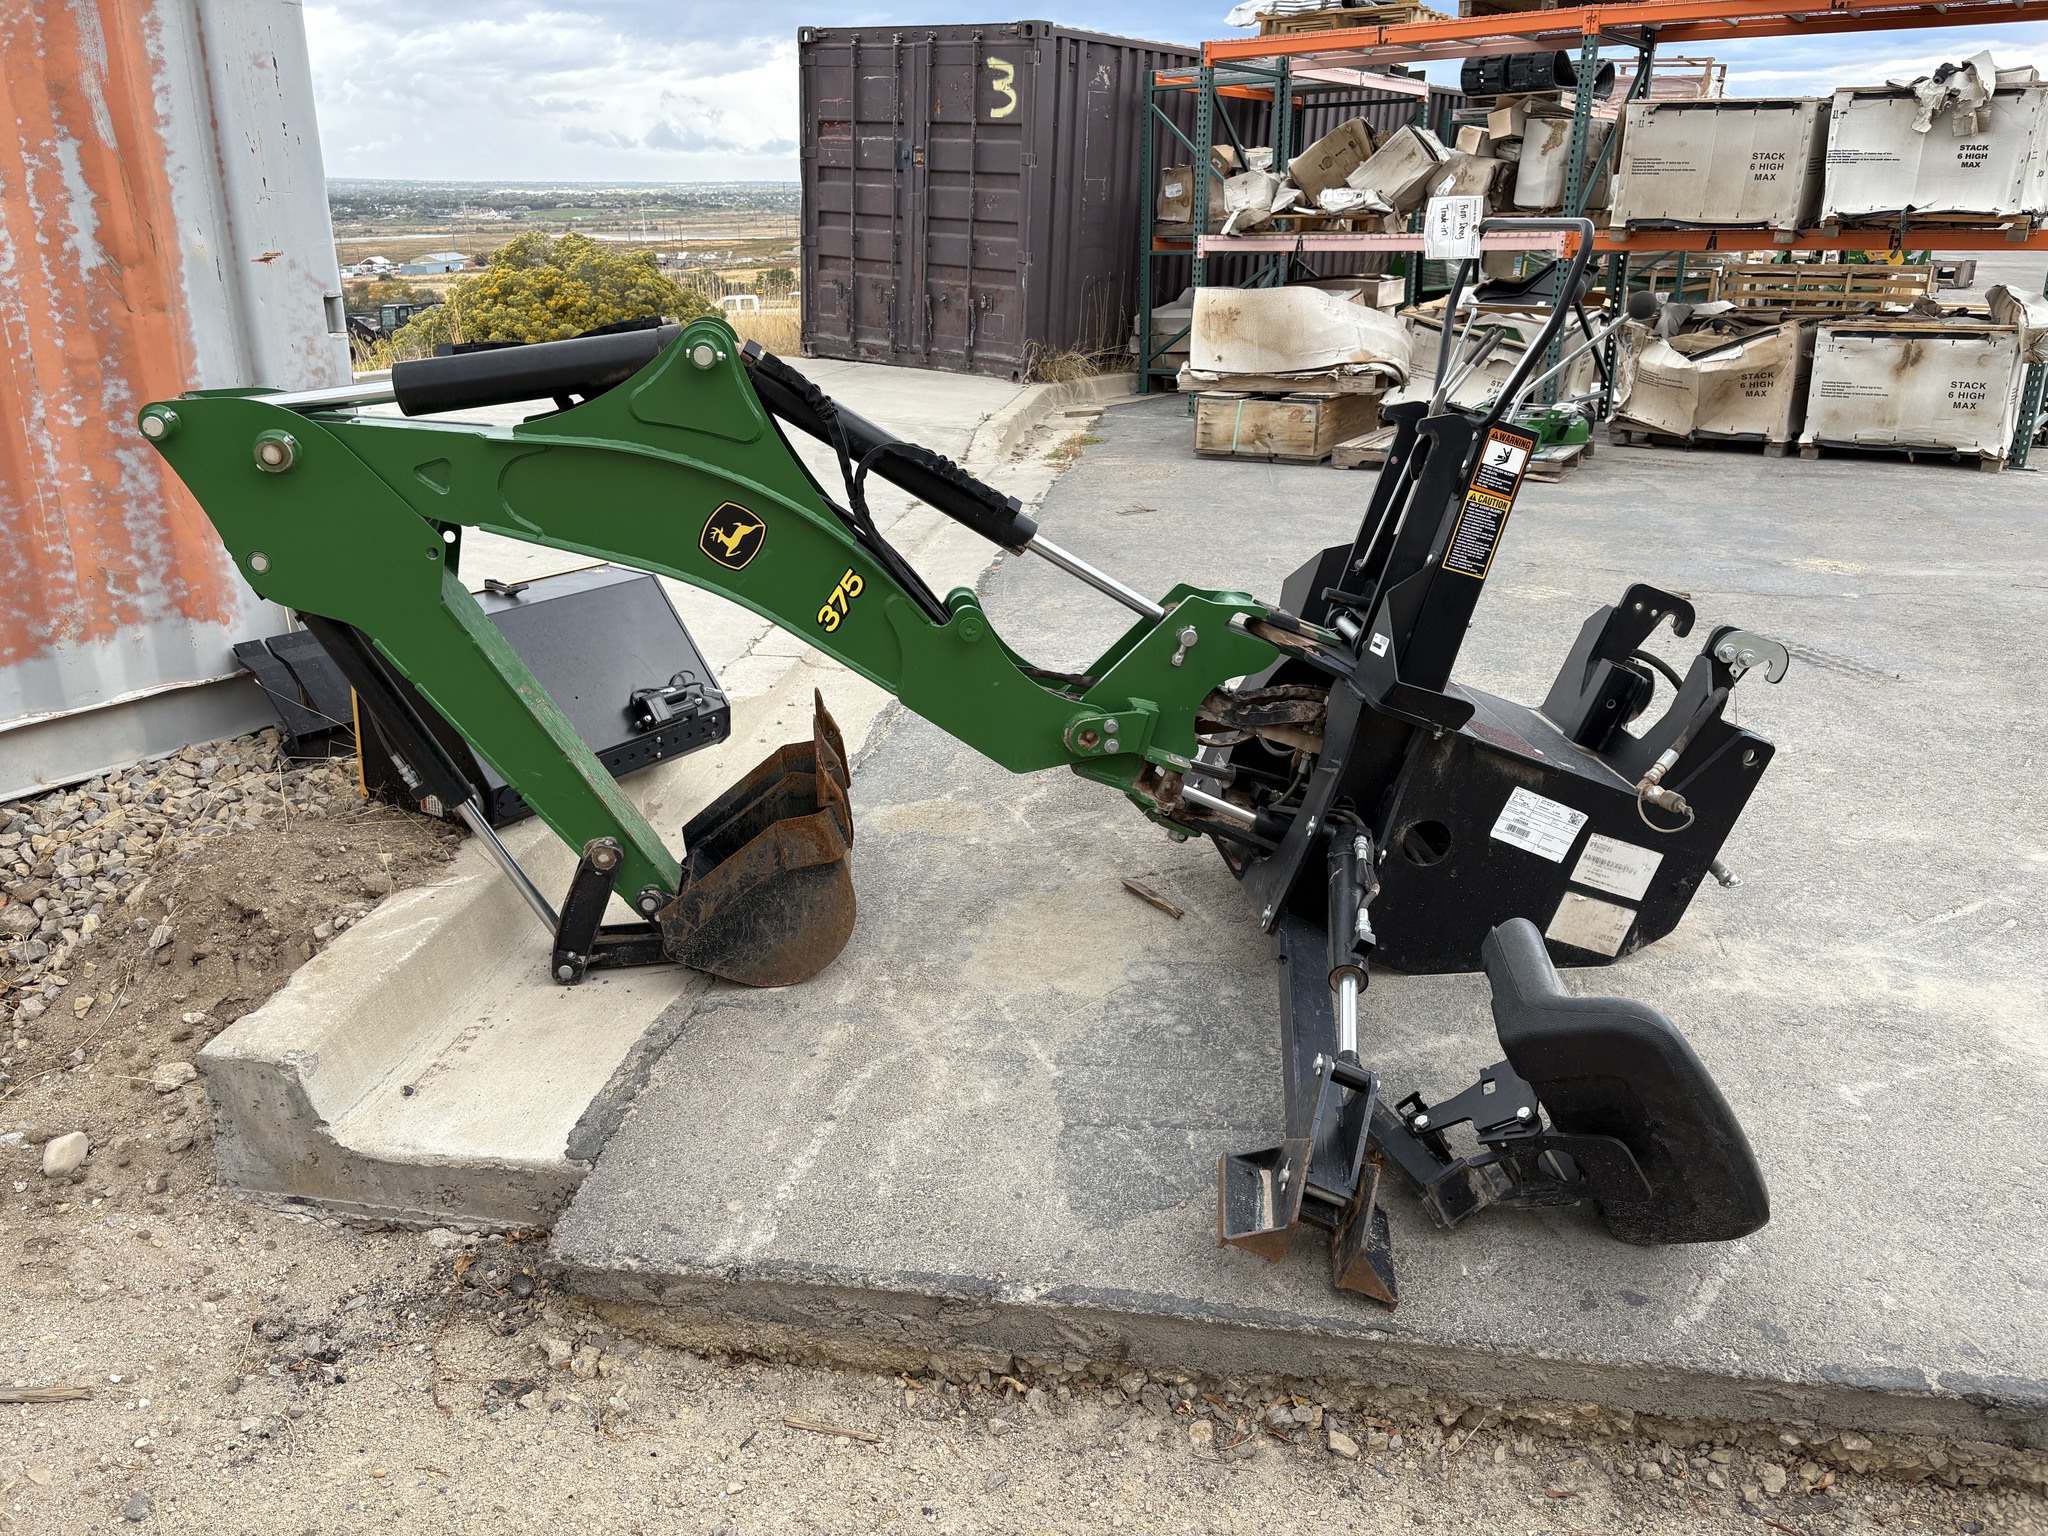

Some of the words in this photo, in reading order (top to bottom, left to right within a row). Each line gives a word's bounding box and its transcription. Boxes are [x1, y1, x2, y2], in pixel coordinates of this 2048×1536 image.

[987, 56, 1016, 117] 3
[1752, 152, 1786, 160] STACK
[1750, 163, 1756, 171] 6
[1758, 163, 1784, 171] HIGH
[1740, 371, 1774, 381] STACK
[1950, 381, 1986, 390] STACK
[1957, 392, 1985, 400] HIGH
[1952, 402, 1977, 410] MAX
[1499, 432, 1531, 450] WARNING
[1477, 494, 1509, 510] CAUTION
[818, 567, 866, 633] 375
